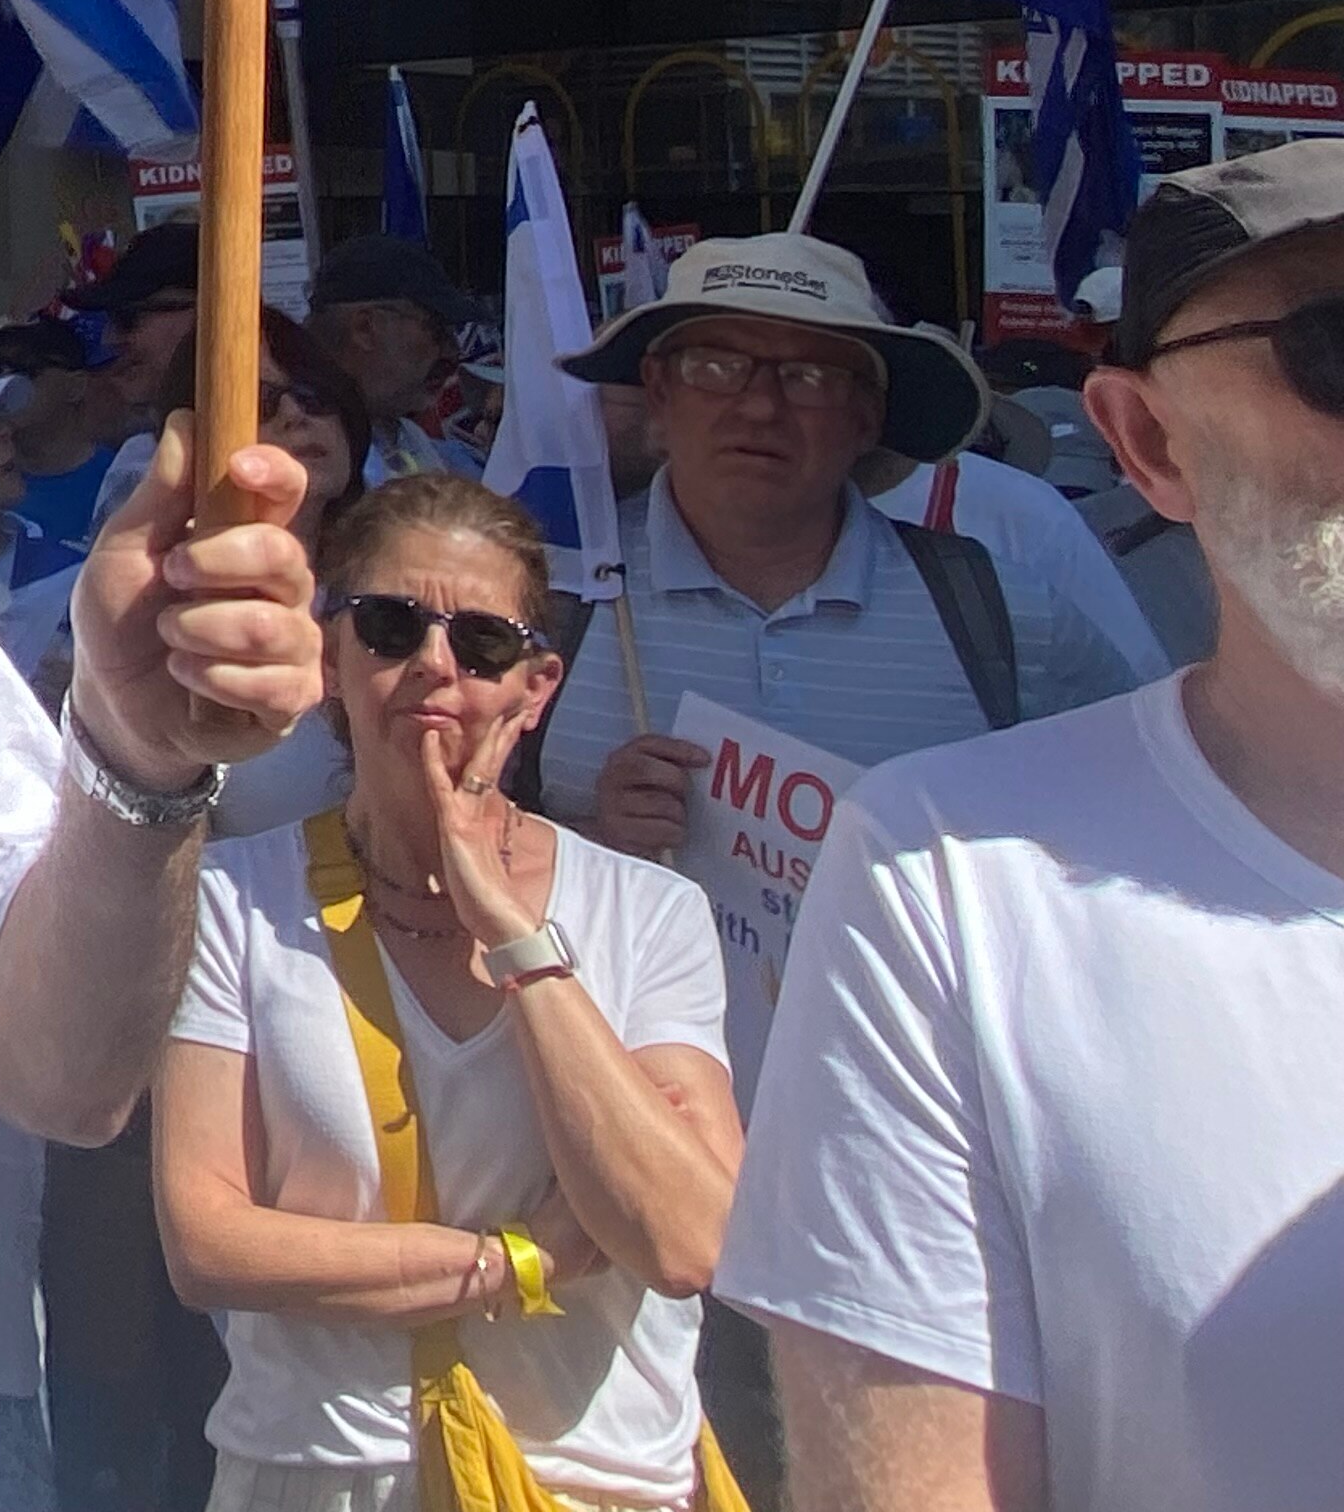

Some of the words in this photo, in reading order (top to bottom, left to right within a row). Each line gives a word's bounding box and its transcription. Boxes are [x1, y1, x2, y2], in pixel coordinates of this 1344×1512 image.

[996, 60, 1210, 86] KIPPED
[1221, 80, 1337, 108] KIDNAPPED
[139, 154, 293, 186] KIDNED
[710, 737, 835, 841] MO
[715, 903, 759, 954] ith
